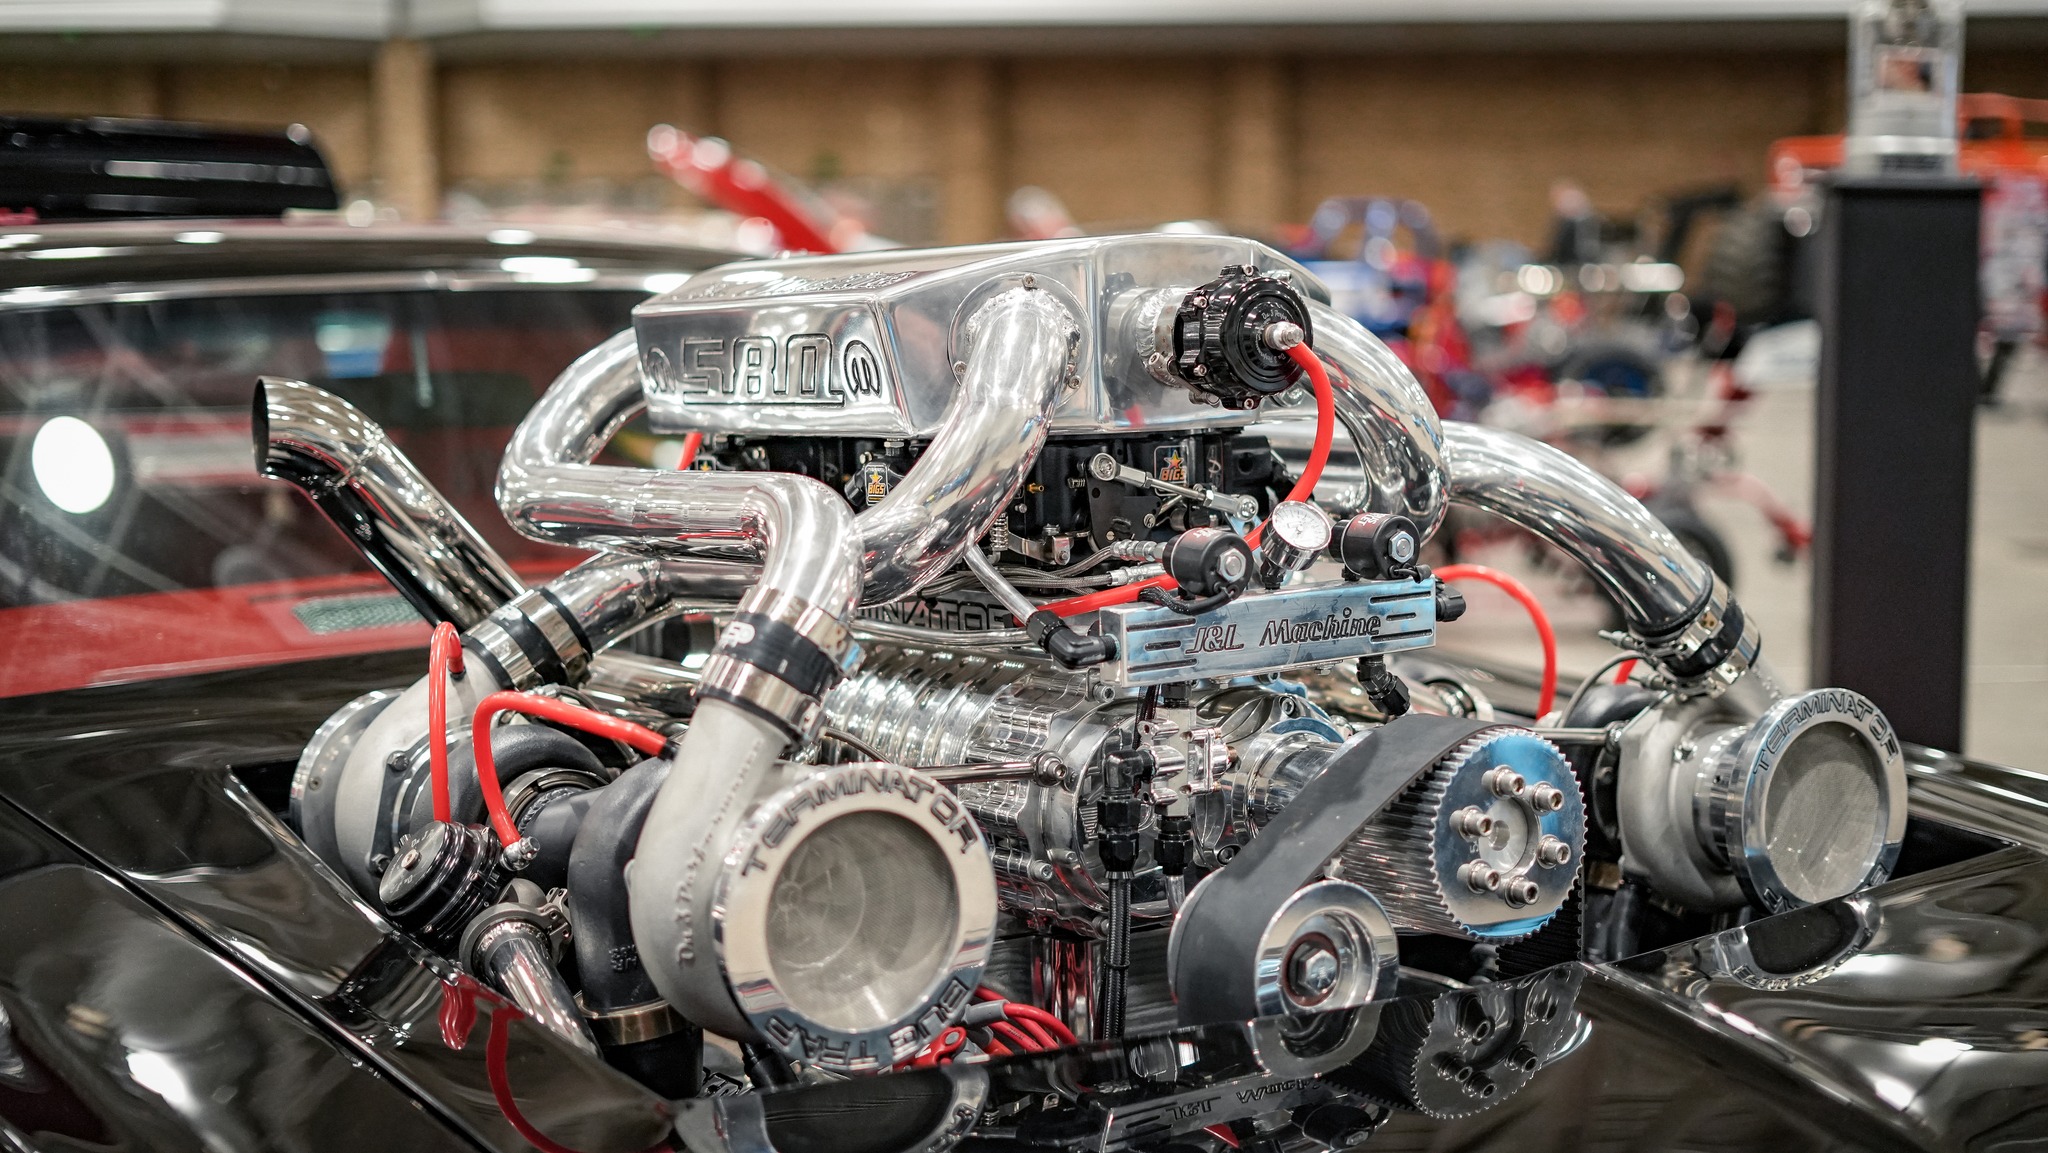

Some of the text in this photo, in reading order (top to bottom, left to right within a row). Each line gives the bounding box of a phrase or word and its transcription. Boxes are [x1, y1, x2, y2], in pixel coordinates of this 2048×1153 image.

[681, 334, 844, 408] 580
[1184, 607, 1381, 654] J&L Machine
[1753, 692, 1899, 776] TERMINATOR
[741, 769, 979, 878] TERMINATOR
[764, 1016, 880, 1072] TRAP
